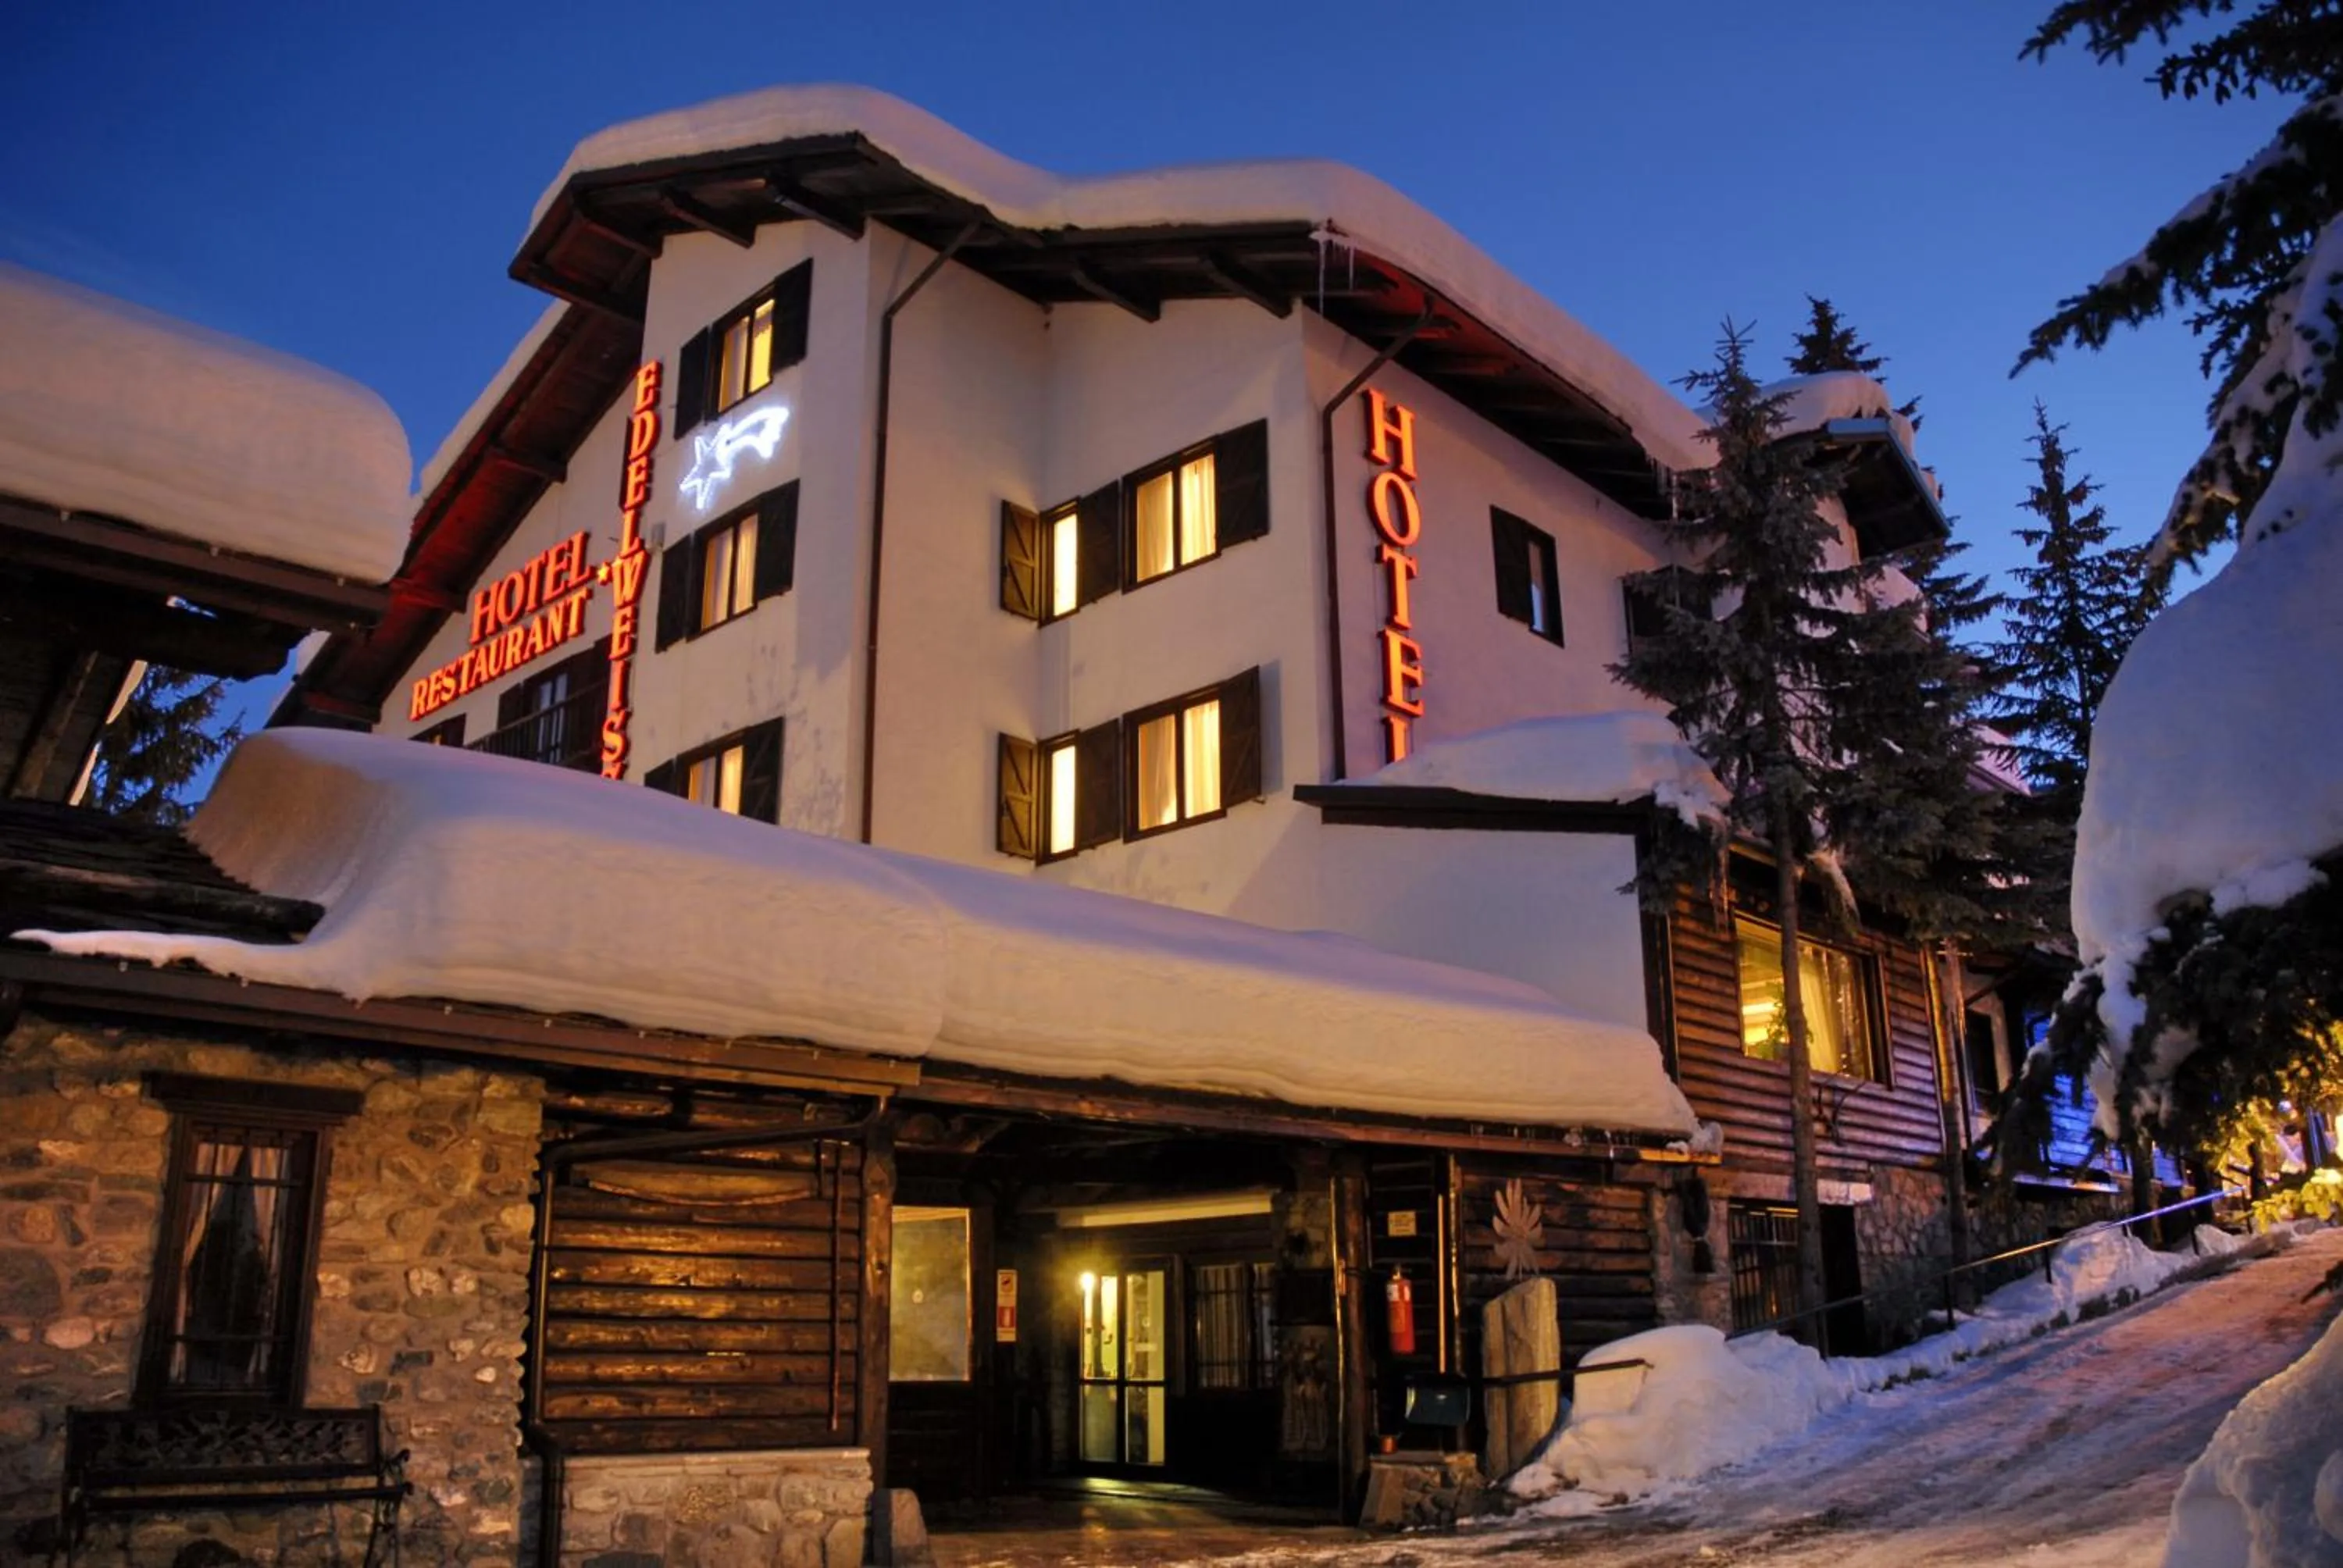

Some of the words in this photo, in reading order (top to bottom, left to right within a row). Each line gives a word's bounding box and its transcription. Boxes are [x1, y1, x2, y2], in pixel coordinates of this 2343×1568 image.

[469, 532, 592, 645] HOTEL
[600, 360, 660, 780] EDELWEIS
[409, 587, 592, 722] RESTAURANT
